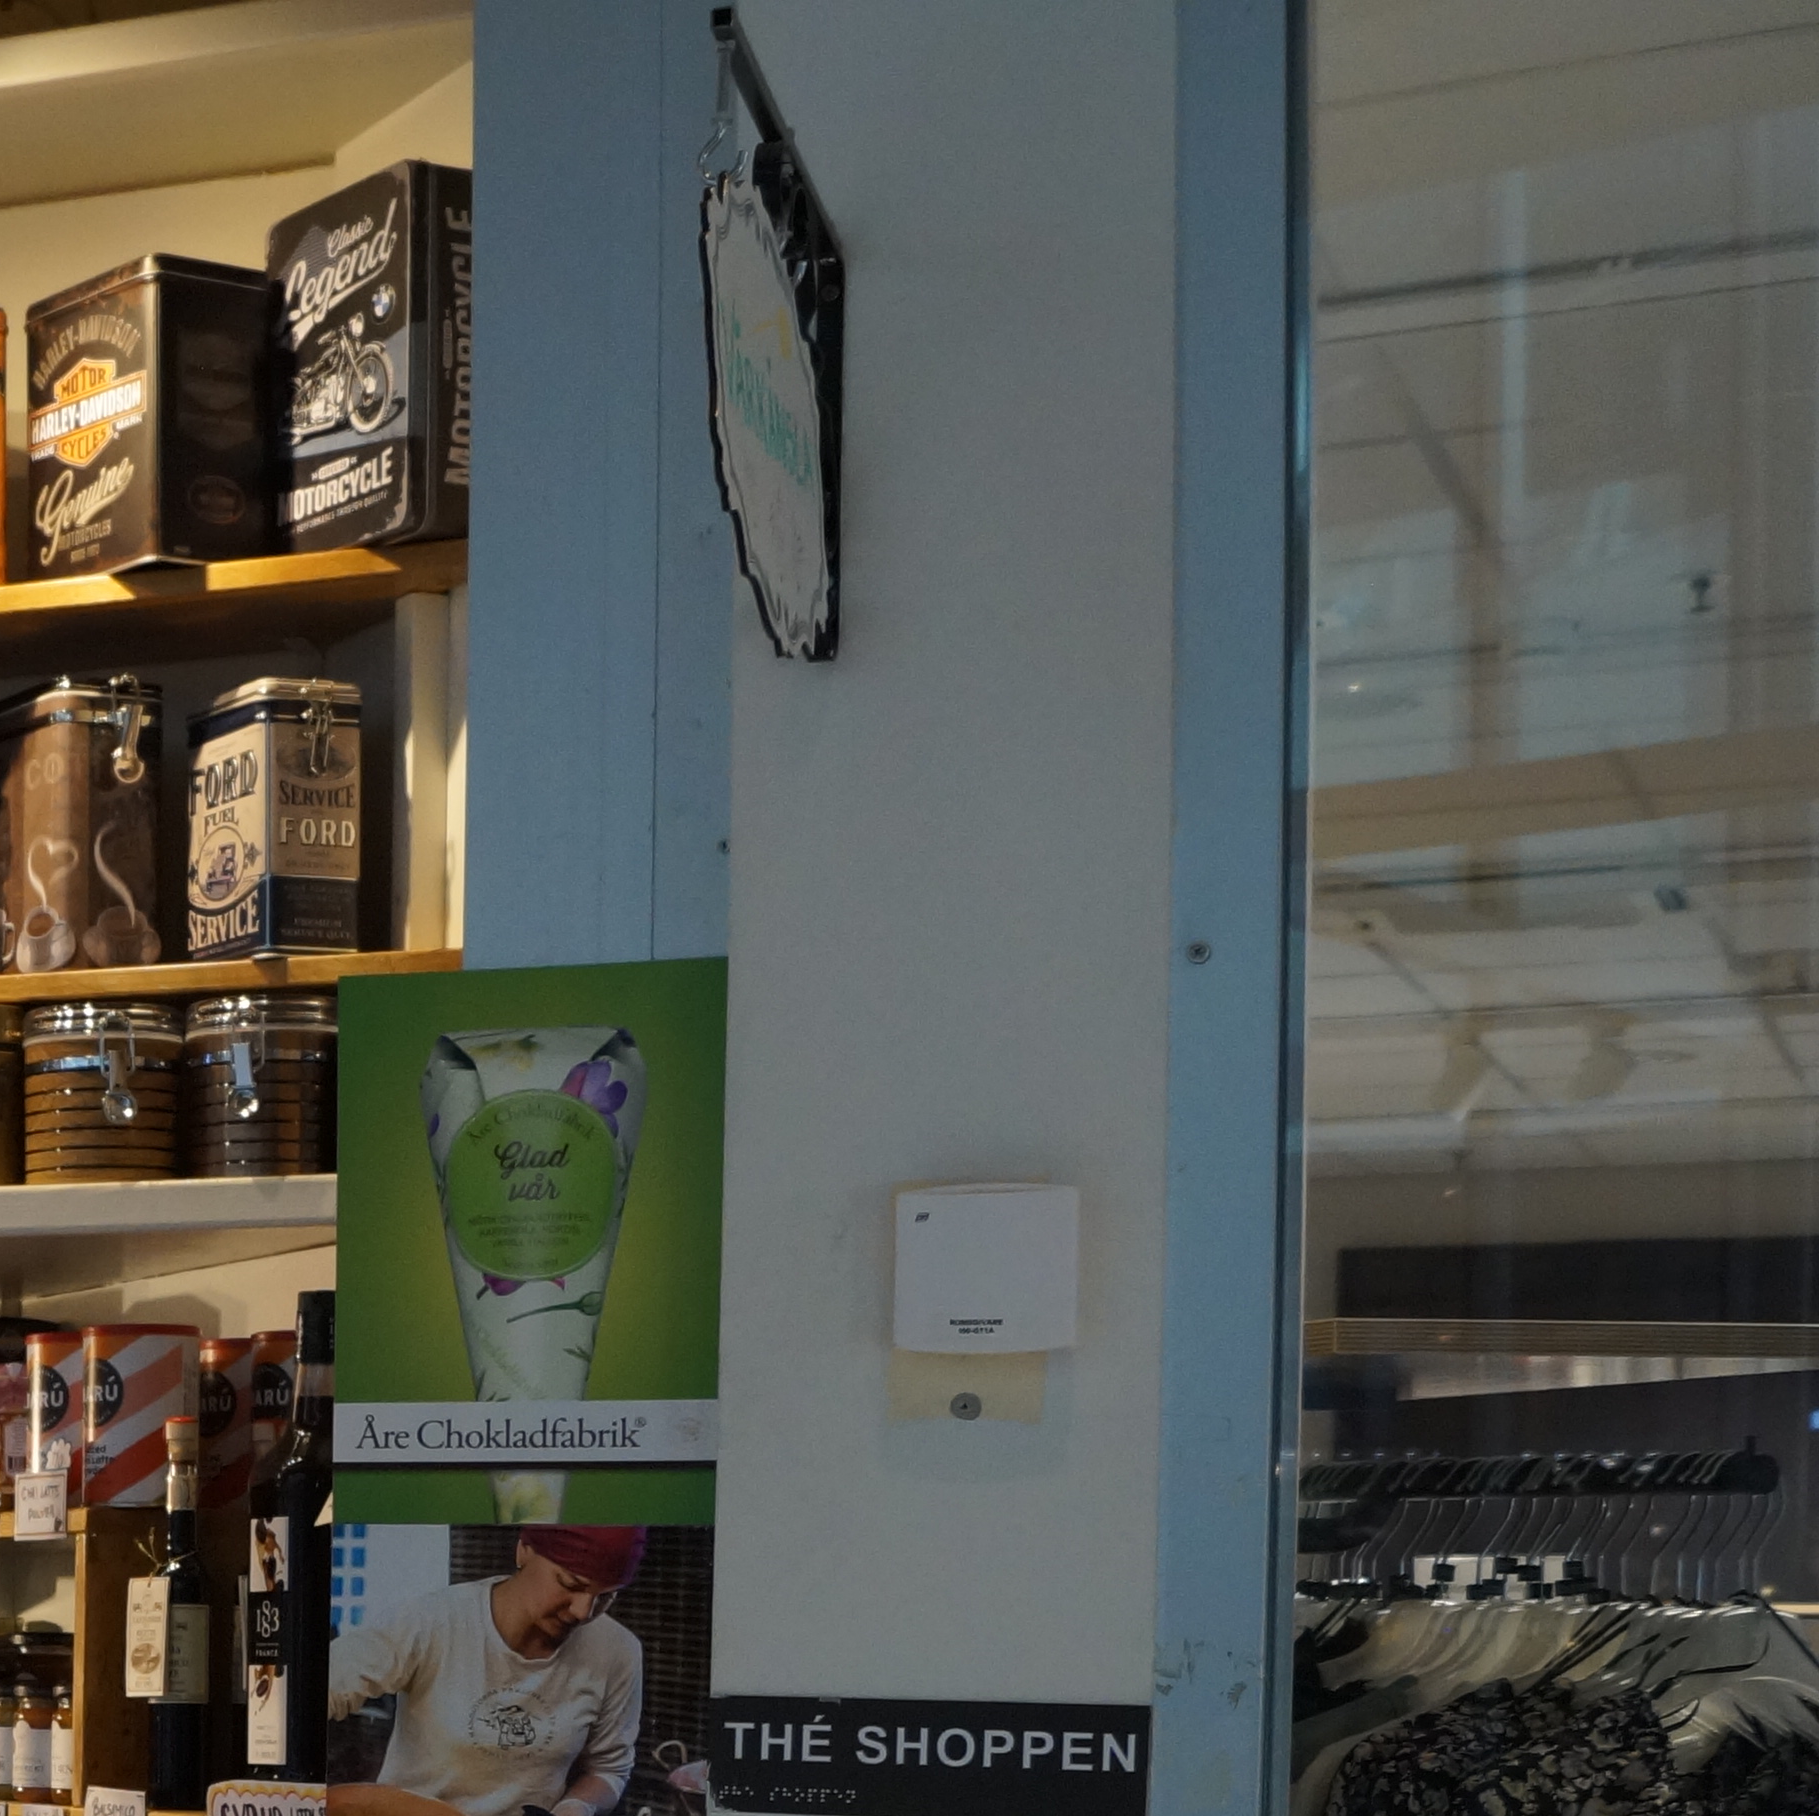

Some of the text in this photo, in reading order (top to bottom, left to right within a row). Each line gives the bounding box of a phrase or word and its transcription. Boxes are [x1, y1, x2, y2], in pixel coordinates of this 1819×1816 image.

[326, 214, 374, 258] Classic
[285, 197, 397, 323] Legend
[60, 366, 107, 397] MOTOR
[31, 379, 141, 444] HARLEY-DAVIDSON
[63, 427, 108, 460] CYCLES
[35, 457, 135, 567] Genuine
[188, 750, 259, 817] FORD
[279, 779, 356, 808] SERVICE
[203, 806, 240, 837] FUEL
[279, 817, 356, 847] FORD
[187, 890, 260, 951] SERVICE
[493, 1139, 570, 1181] Glad
[508, 1173, 561, 1203] vår
[355, 1415, 643, 1451] Åre Chokladfabrik
[723, 1714, 1137, 1773] THÉ SHOPPEN
